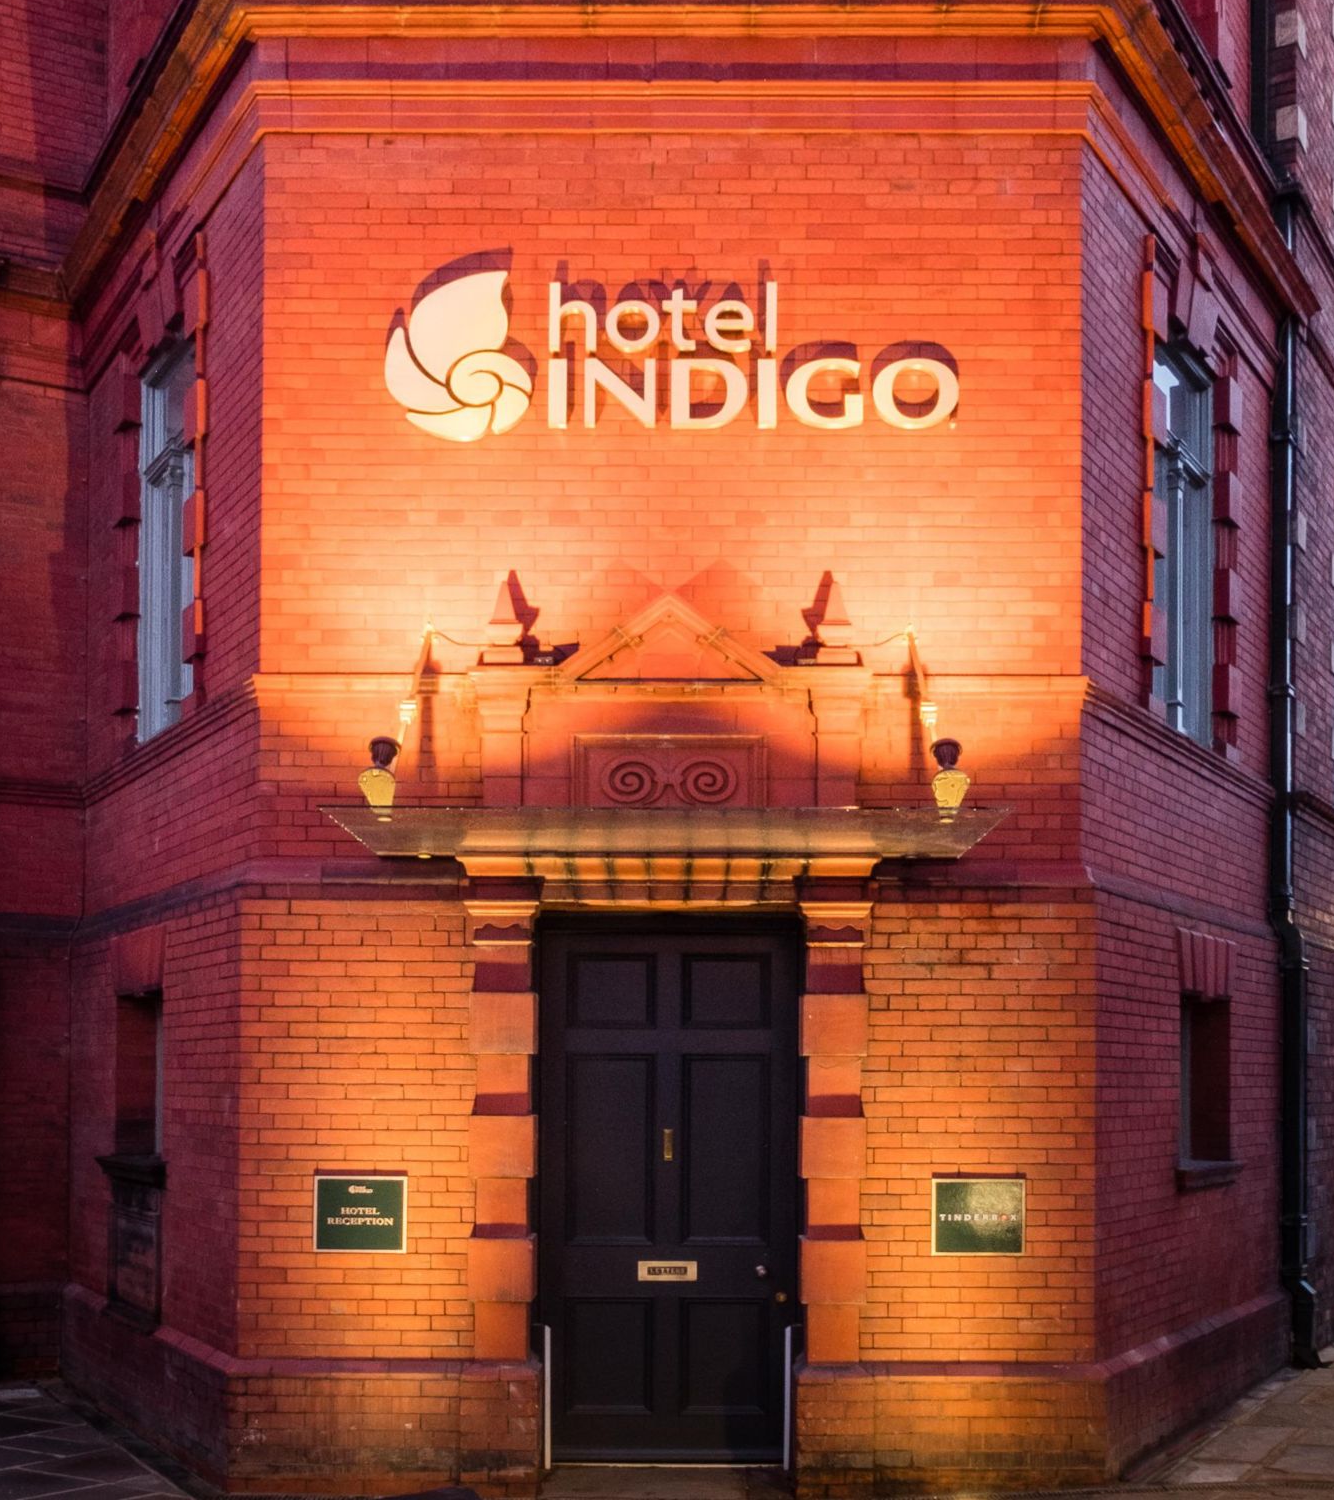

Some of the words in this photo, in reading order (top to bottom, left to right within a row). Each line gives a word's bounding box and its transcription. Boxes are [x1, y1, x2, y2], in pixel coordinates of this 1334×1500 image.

[548, 281, 778, 353] hotel
[547, 356, 960, 430] INDIGO
[340, 1207, 380, 1215] HOTEL
[327, 1217, 394, 1226] RECEPTION
[650, 1267, 685, 1275] LETTERS
